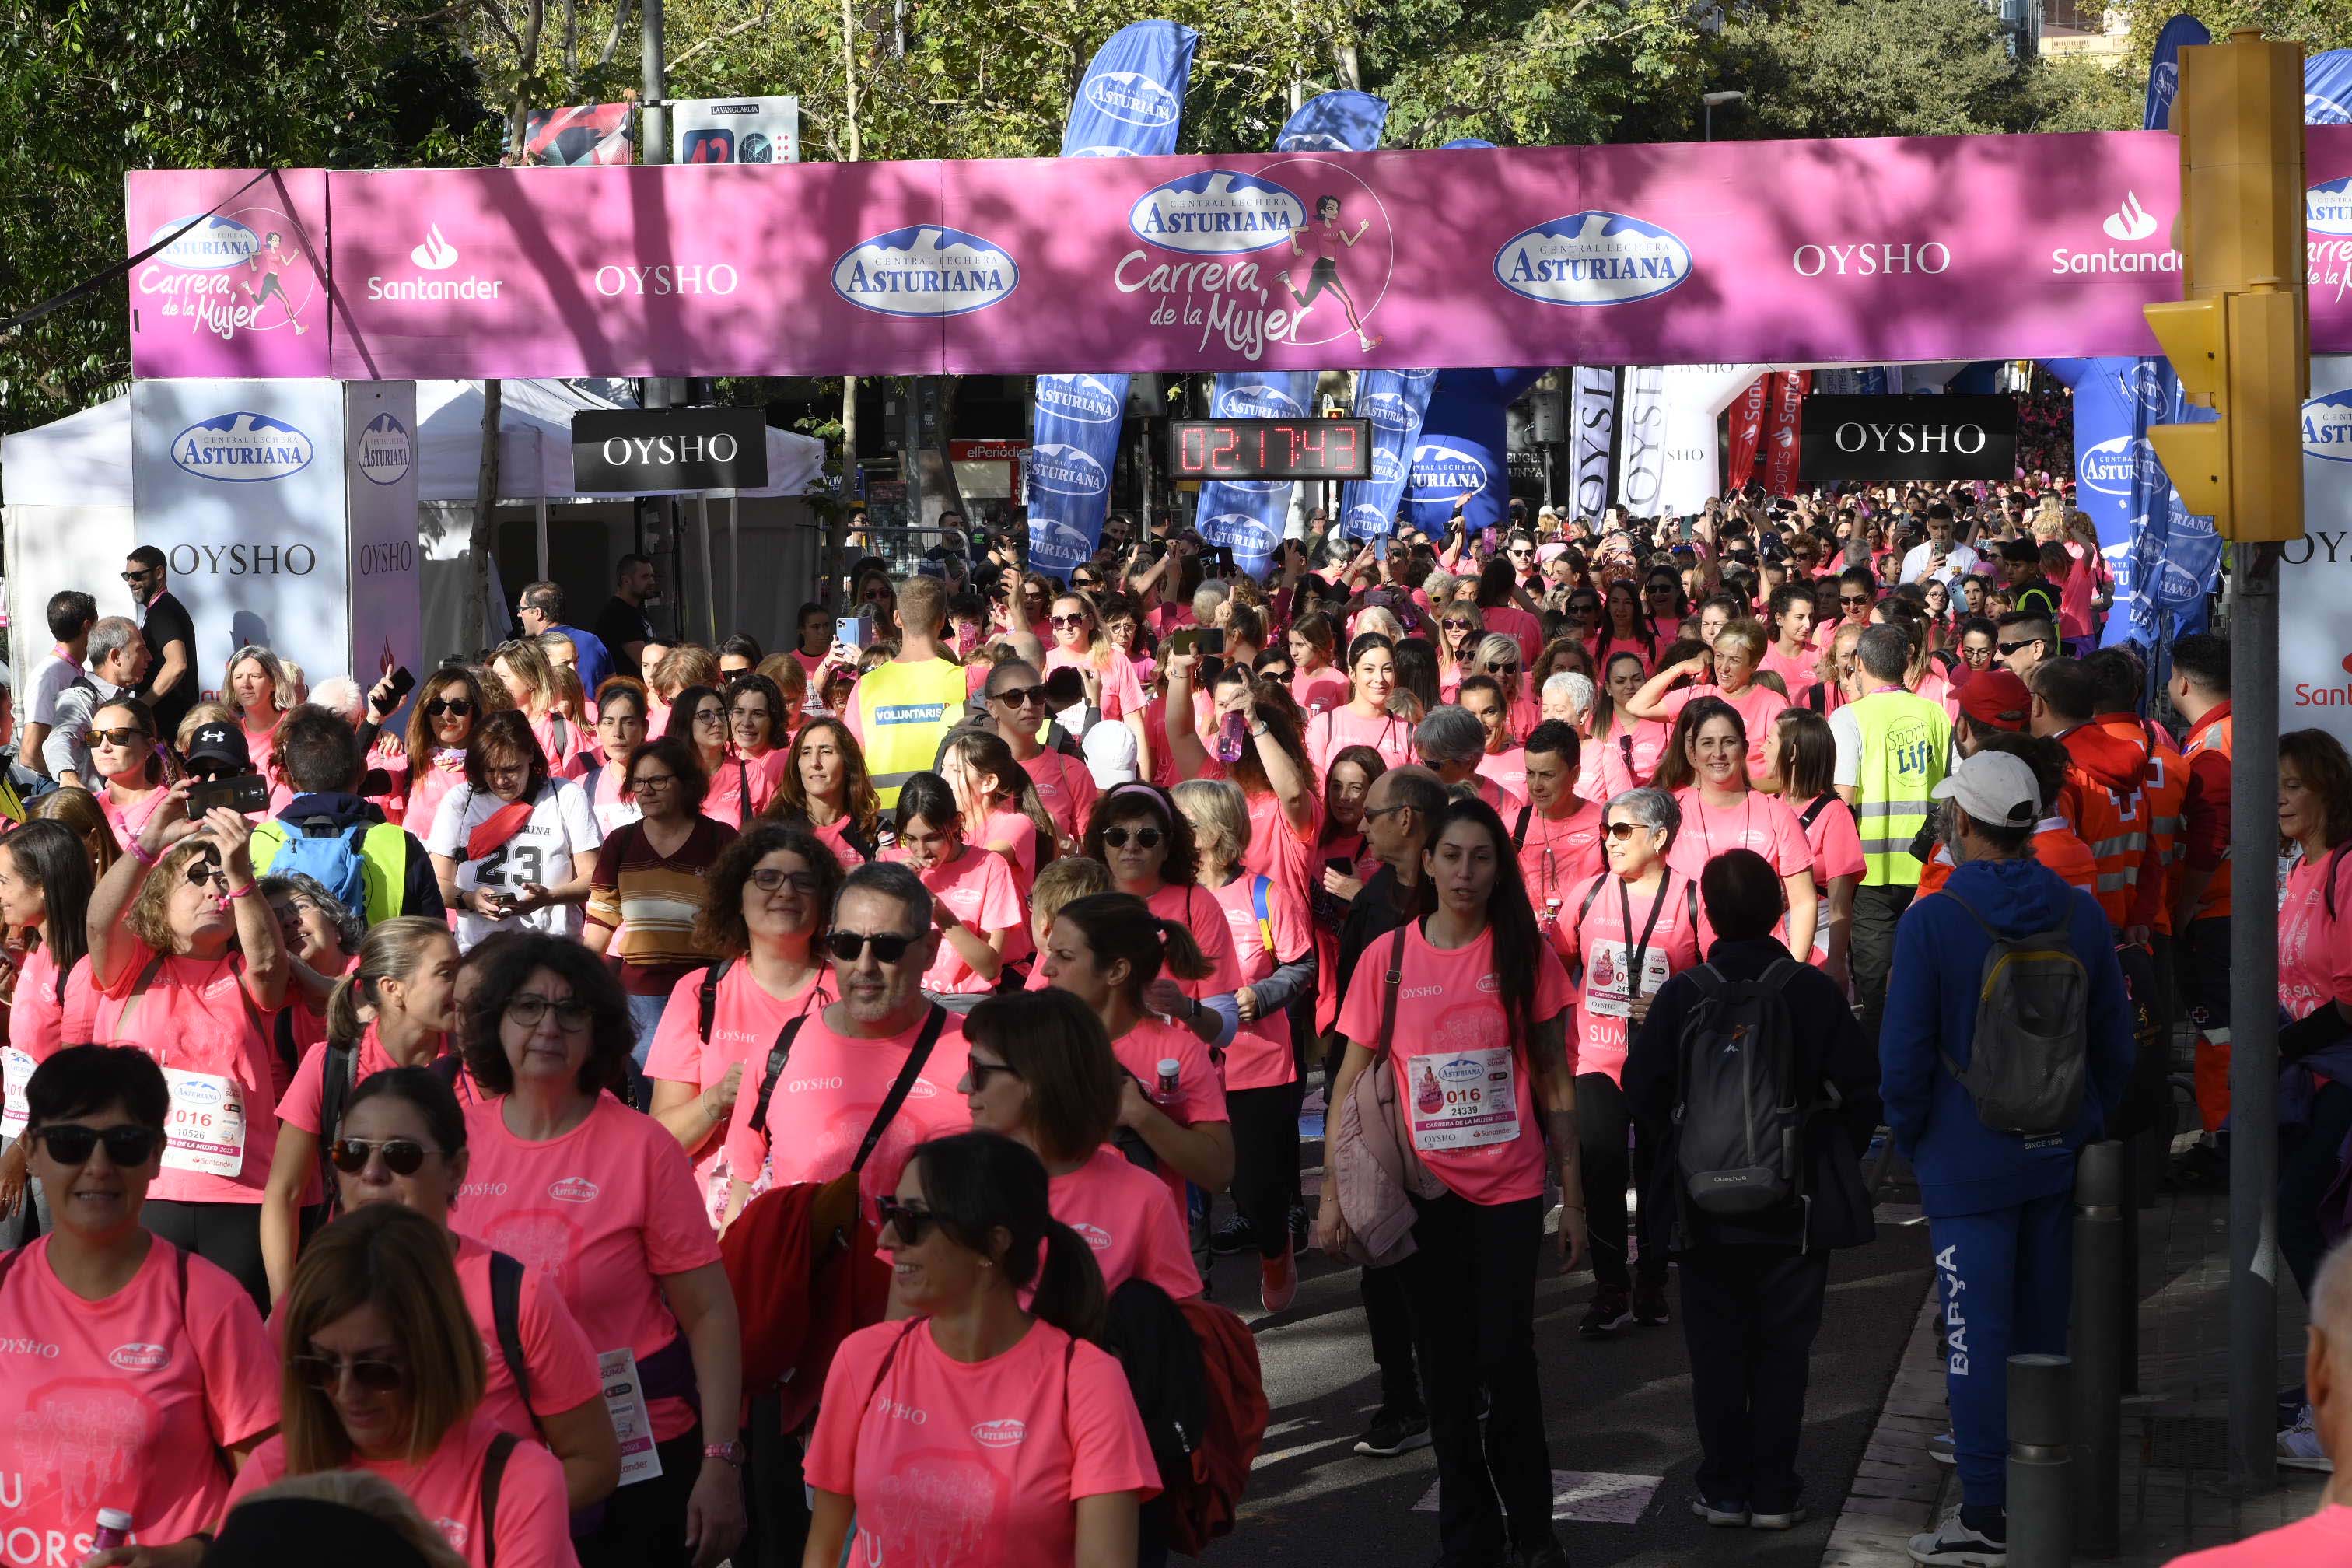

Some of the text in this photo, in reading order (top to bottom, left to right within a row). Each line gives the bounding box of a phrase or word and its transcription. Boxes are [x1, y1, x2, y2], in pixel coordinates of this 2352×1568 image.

[720, 105, 759, 114] VANGUARDIA
[1090, 82, 1171, 121] ASTURIANA
[1170, 198, 1288, 208] CENTRAL LECHERA
[1143, 201, 1293, 234] ASTURIANA
[875, 255, 999, 265] CENTRAL LECHERA
[1540, 243, 1670, 254] CENTRAL LECHERA
[1793, 242, 1951, 277] OYSHO
[846, 259, 1004, 294] ASTURIANA
[1115, 250, 1259, 294] Carrera
[1510, 247, 1677, 282] ASTURIANA
[2324, 258, 2339, 285] la
[138, 264, 230, 295] Carrera
[368, 275, 502, 301] Santander
[594, 264, 738, 296] OYSHO
[162, 292, 265, 340] de la Mujer
[1150, 288, 1314, 361] de la Mujer
[1035, 381, 1112, 418] ASTURIANA
[1779, 369, 1800, 424] Santa
[1181, 427, 1356, 471] 02:17:43
[1578, 366, 1612, 517] OYSH
[1626, 367, 1663, 505] OYSH
[1835, 422, 1986, 454] OYSHO
[182, 438, 303, 465] ASTURIANA
[362, 439, 408, 468] ASTURIANA
[603, 432, 738, 467] OYSHO
[1668, 448, 1704, 462] SHO
[1032, 463, 1101, 490] STURIANA
[1407, 473, 1480, 488] TURIANA
[1029, 538, 1087, 562] TURIANA
[1206, 524, 1270, 551] ASTURIANA
[169, 544, 316, 576] OYSHO
[360, 541, 412, 576] OYSHO
[2295, 683, 2352, 706] Sant
[876, 707, 943, 722] VOLUNTARIS
[1888, 722, 1928, 751] Sport
[523, 824, 551, 836] AINA
[474, 845, 544, 887] 23
[1401, 985, 1443, 999] OYSHO
[1591, 1000, 1616, 1010] OYSHO
[1594, 992, 1616, 1000] CARRERA
[1589, 1024, 1627, 1045] SUM
[789, 1076, 843, 1094] OYSHO
[1441, 1066, 1482, 1078] ASTURIANA
[1447, 1088, 1482, 1104] 016
[176, 1110, 212, 1127] 016
[1451, 1105, 1478, 1116] 24339
[178, 1129, 205, 1139] 10526
[1424, 1133, 1456, 1143] OYSHO
[1481, 1127, 1512, 1137] Santander
[195, 1143, 218, 1152] MUJER
[2025, 1141, 2046, 1150] SINCE
[200, 1157, 234, 1168] Santander
